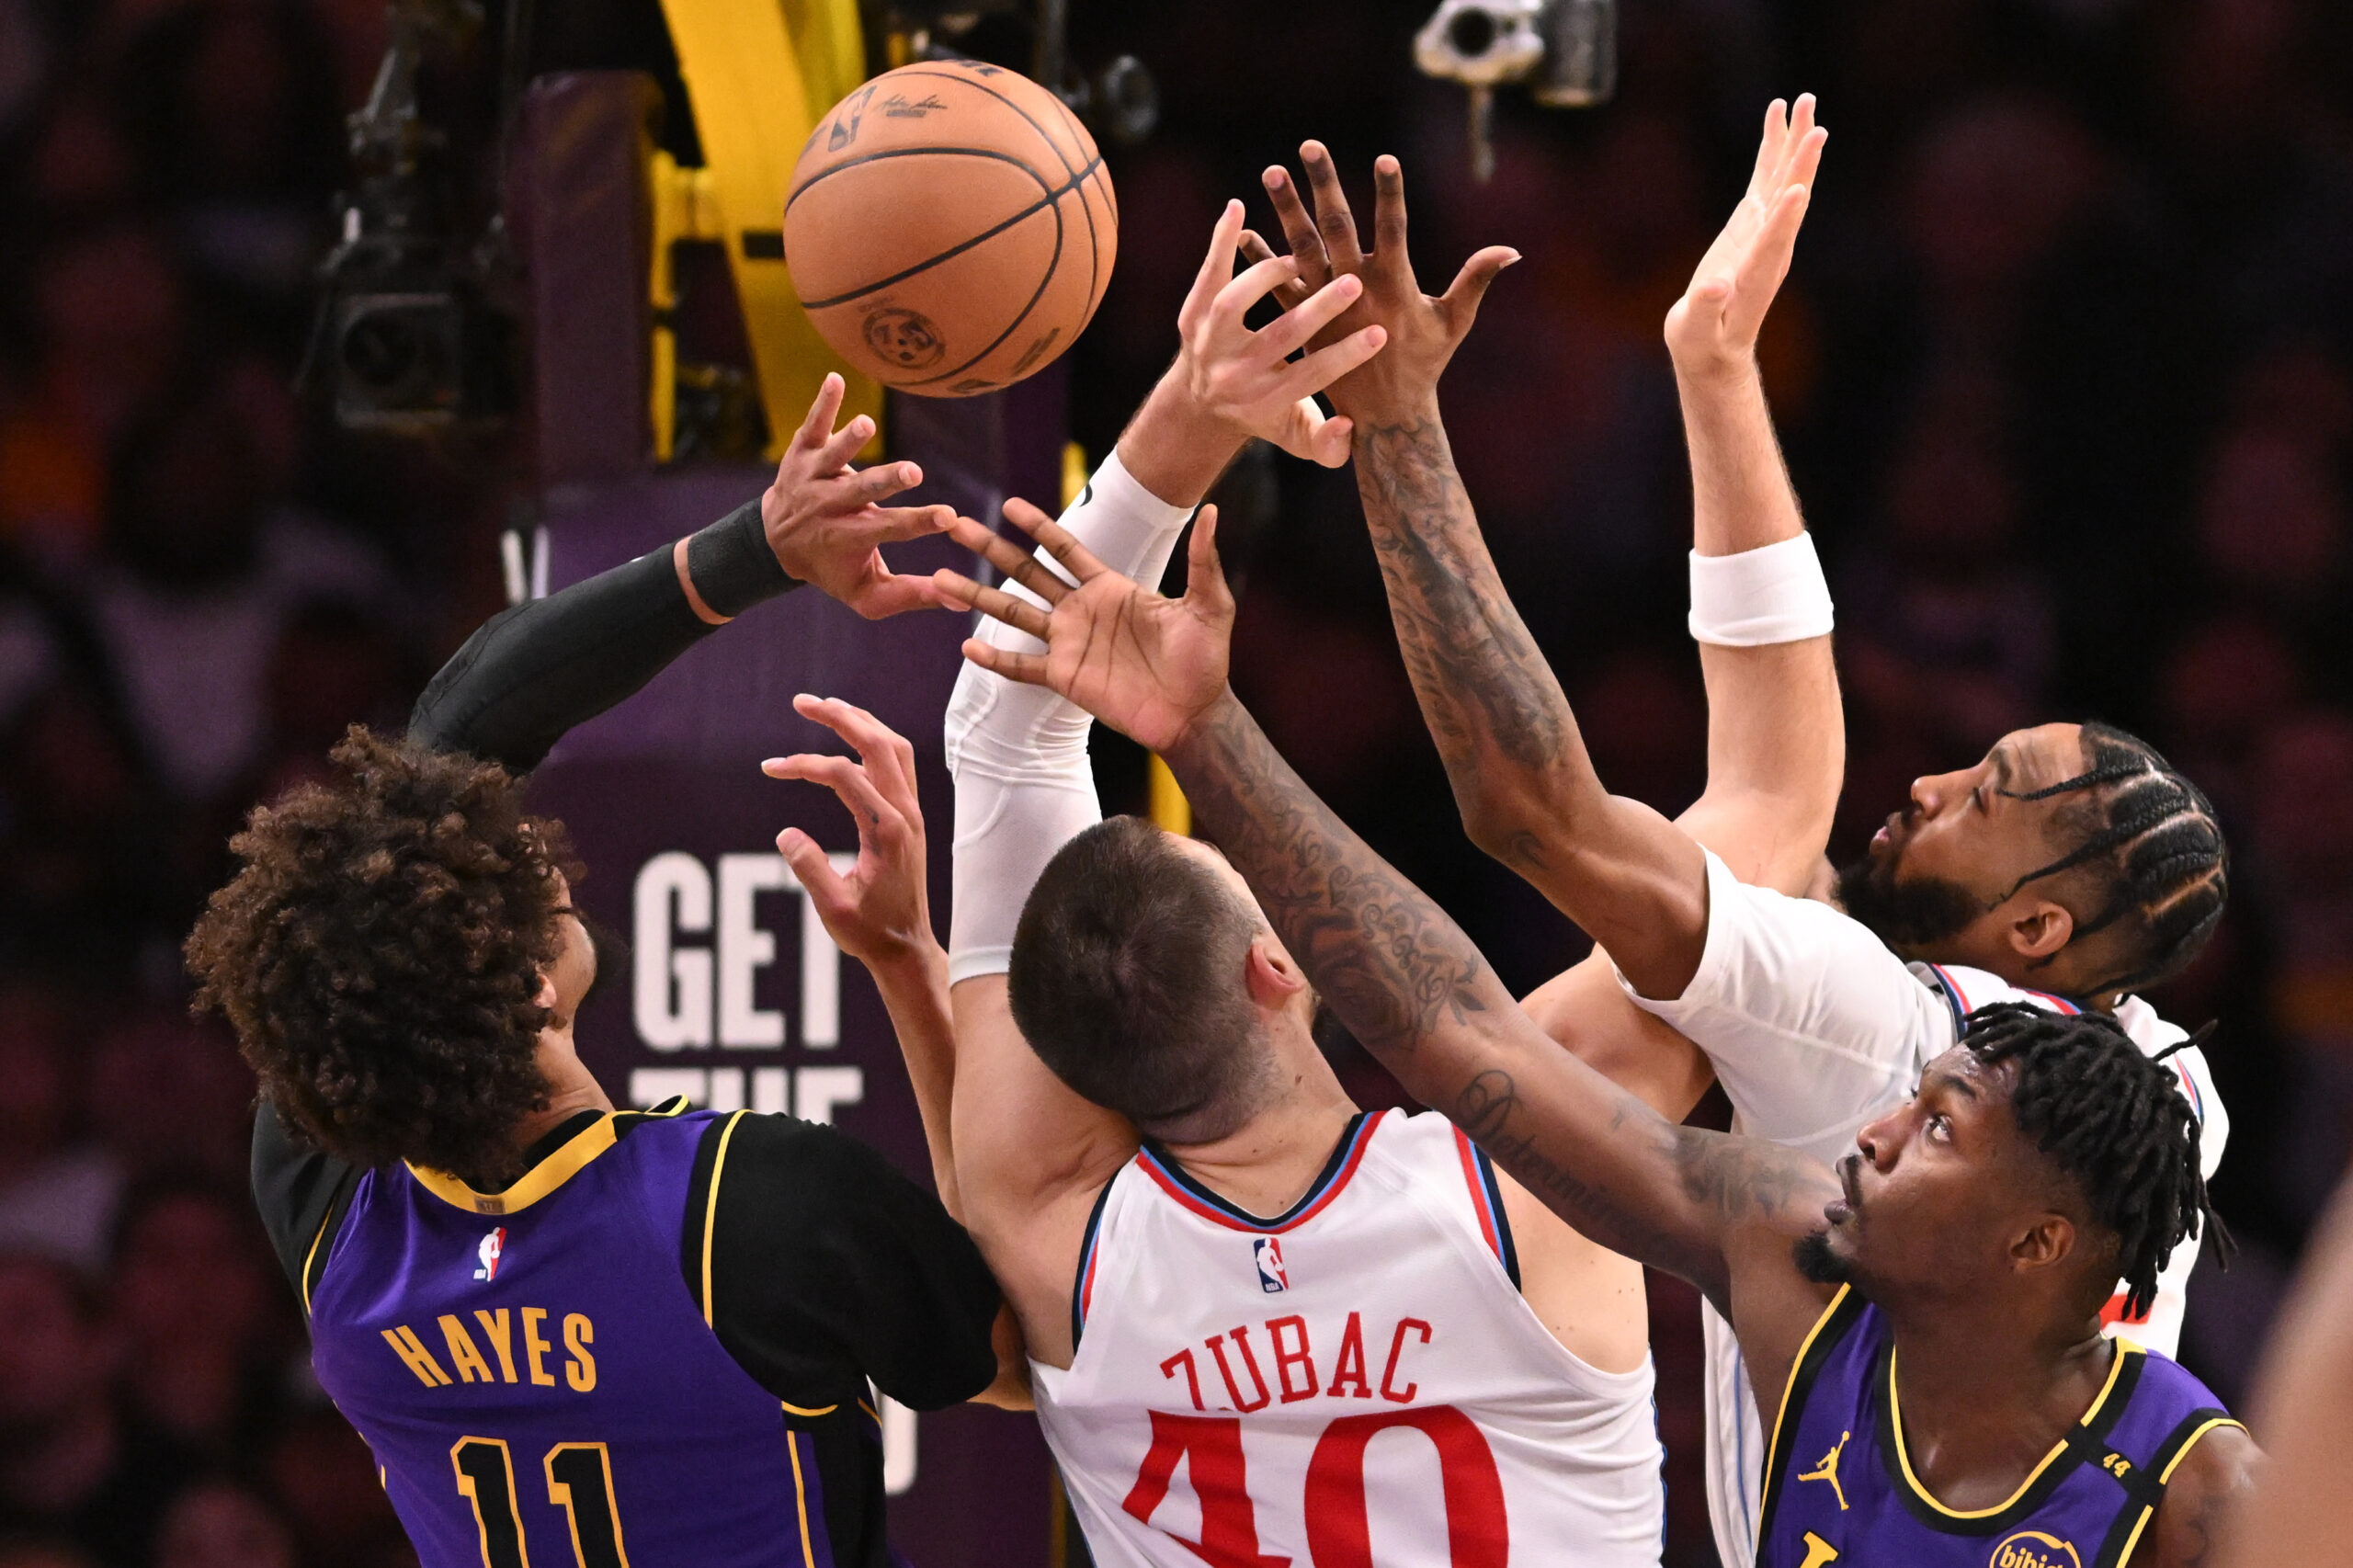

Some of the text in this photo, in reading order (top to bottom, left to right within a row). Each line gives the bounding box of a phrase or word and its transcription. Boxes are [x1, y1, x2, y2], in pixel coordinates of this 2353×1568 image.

[633, 850, 860, 1051] GET
[381, 1307, 597, 1392] HAYES
[1159, 1312, 1431, 1414] ZUBAC
[449, 1435, 631, 1568] 11
[1121, 1404, 1510, 1568] 40
[2103, 1453, 2131, 1478] 44
[1999, 1545, 2063, 1568] bibi
